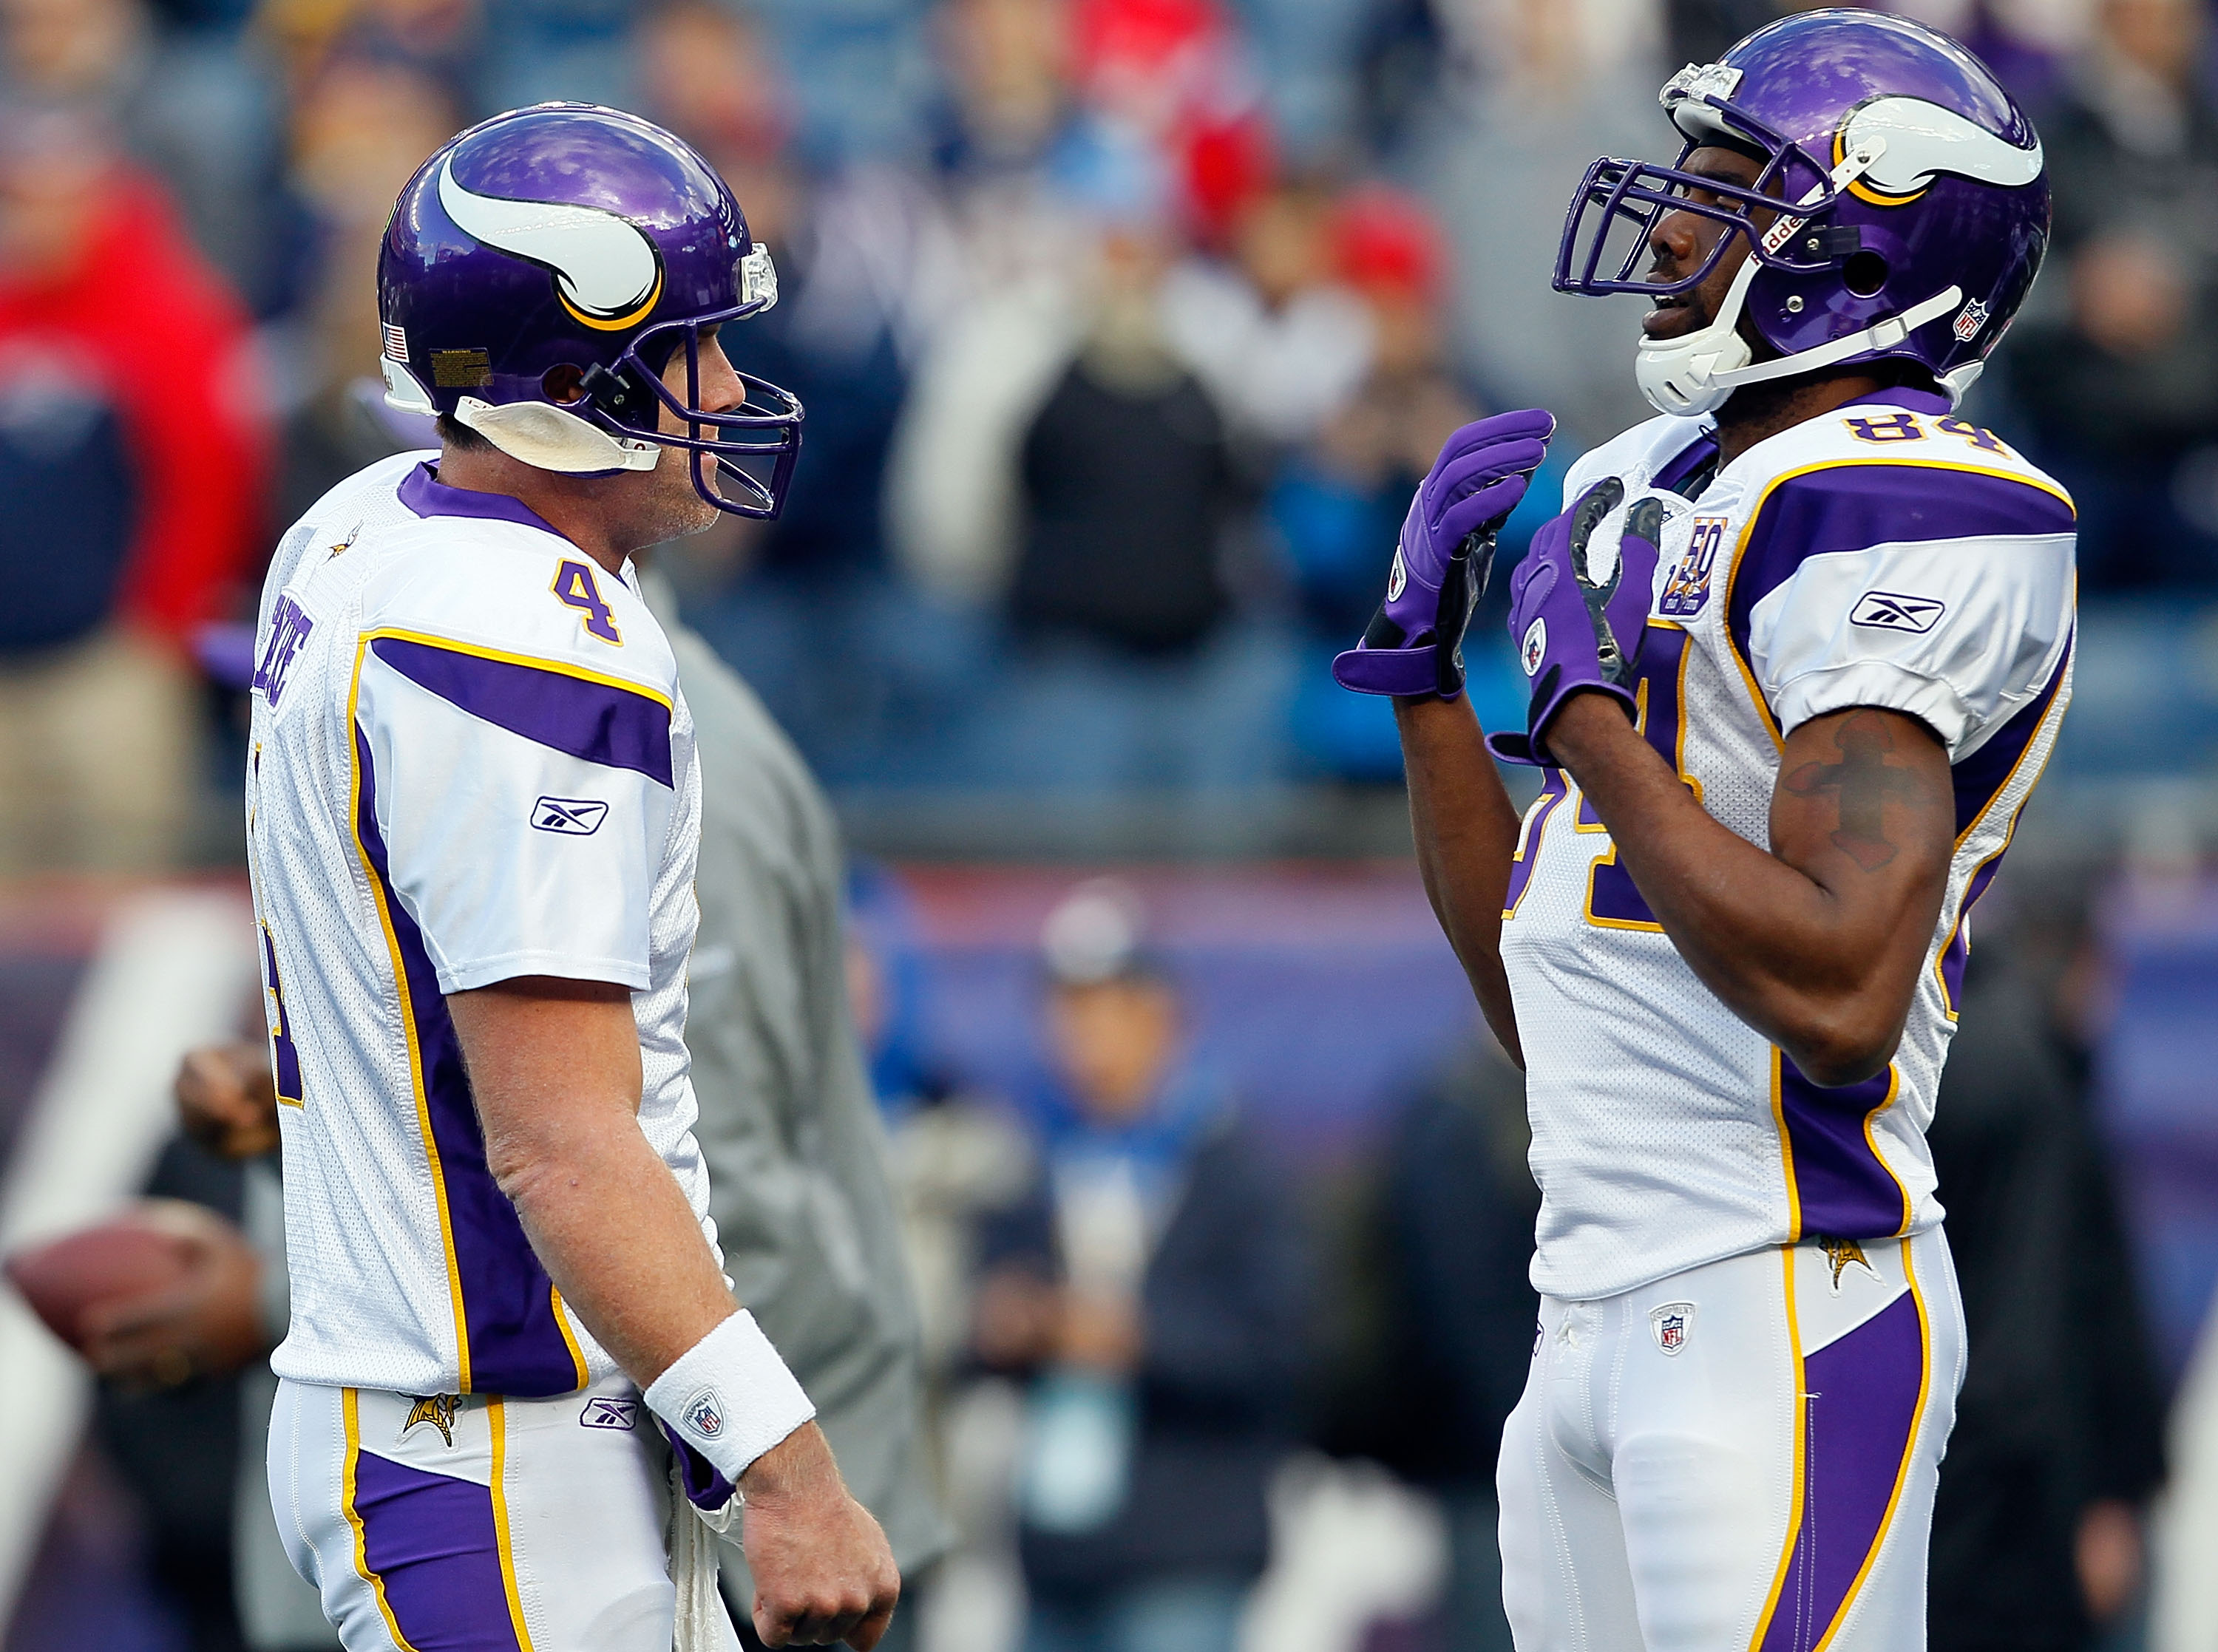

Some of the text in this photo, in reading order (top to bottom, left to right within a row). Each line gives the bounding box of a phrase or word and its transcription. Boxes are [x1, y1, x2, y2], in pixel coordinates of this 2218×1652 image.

[1956, 313, 1977, 337] NFL
[1841, 414, 2012, 460] 84
[549, 557, 623, 647] 4
[1664, 1329, 1681, 1345] NFL
[701, 1415, 719, 1432] NFL
